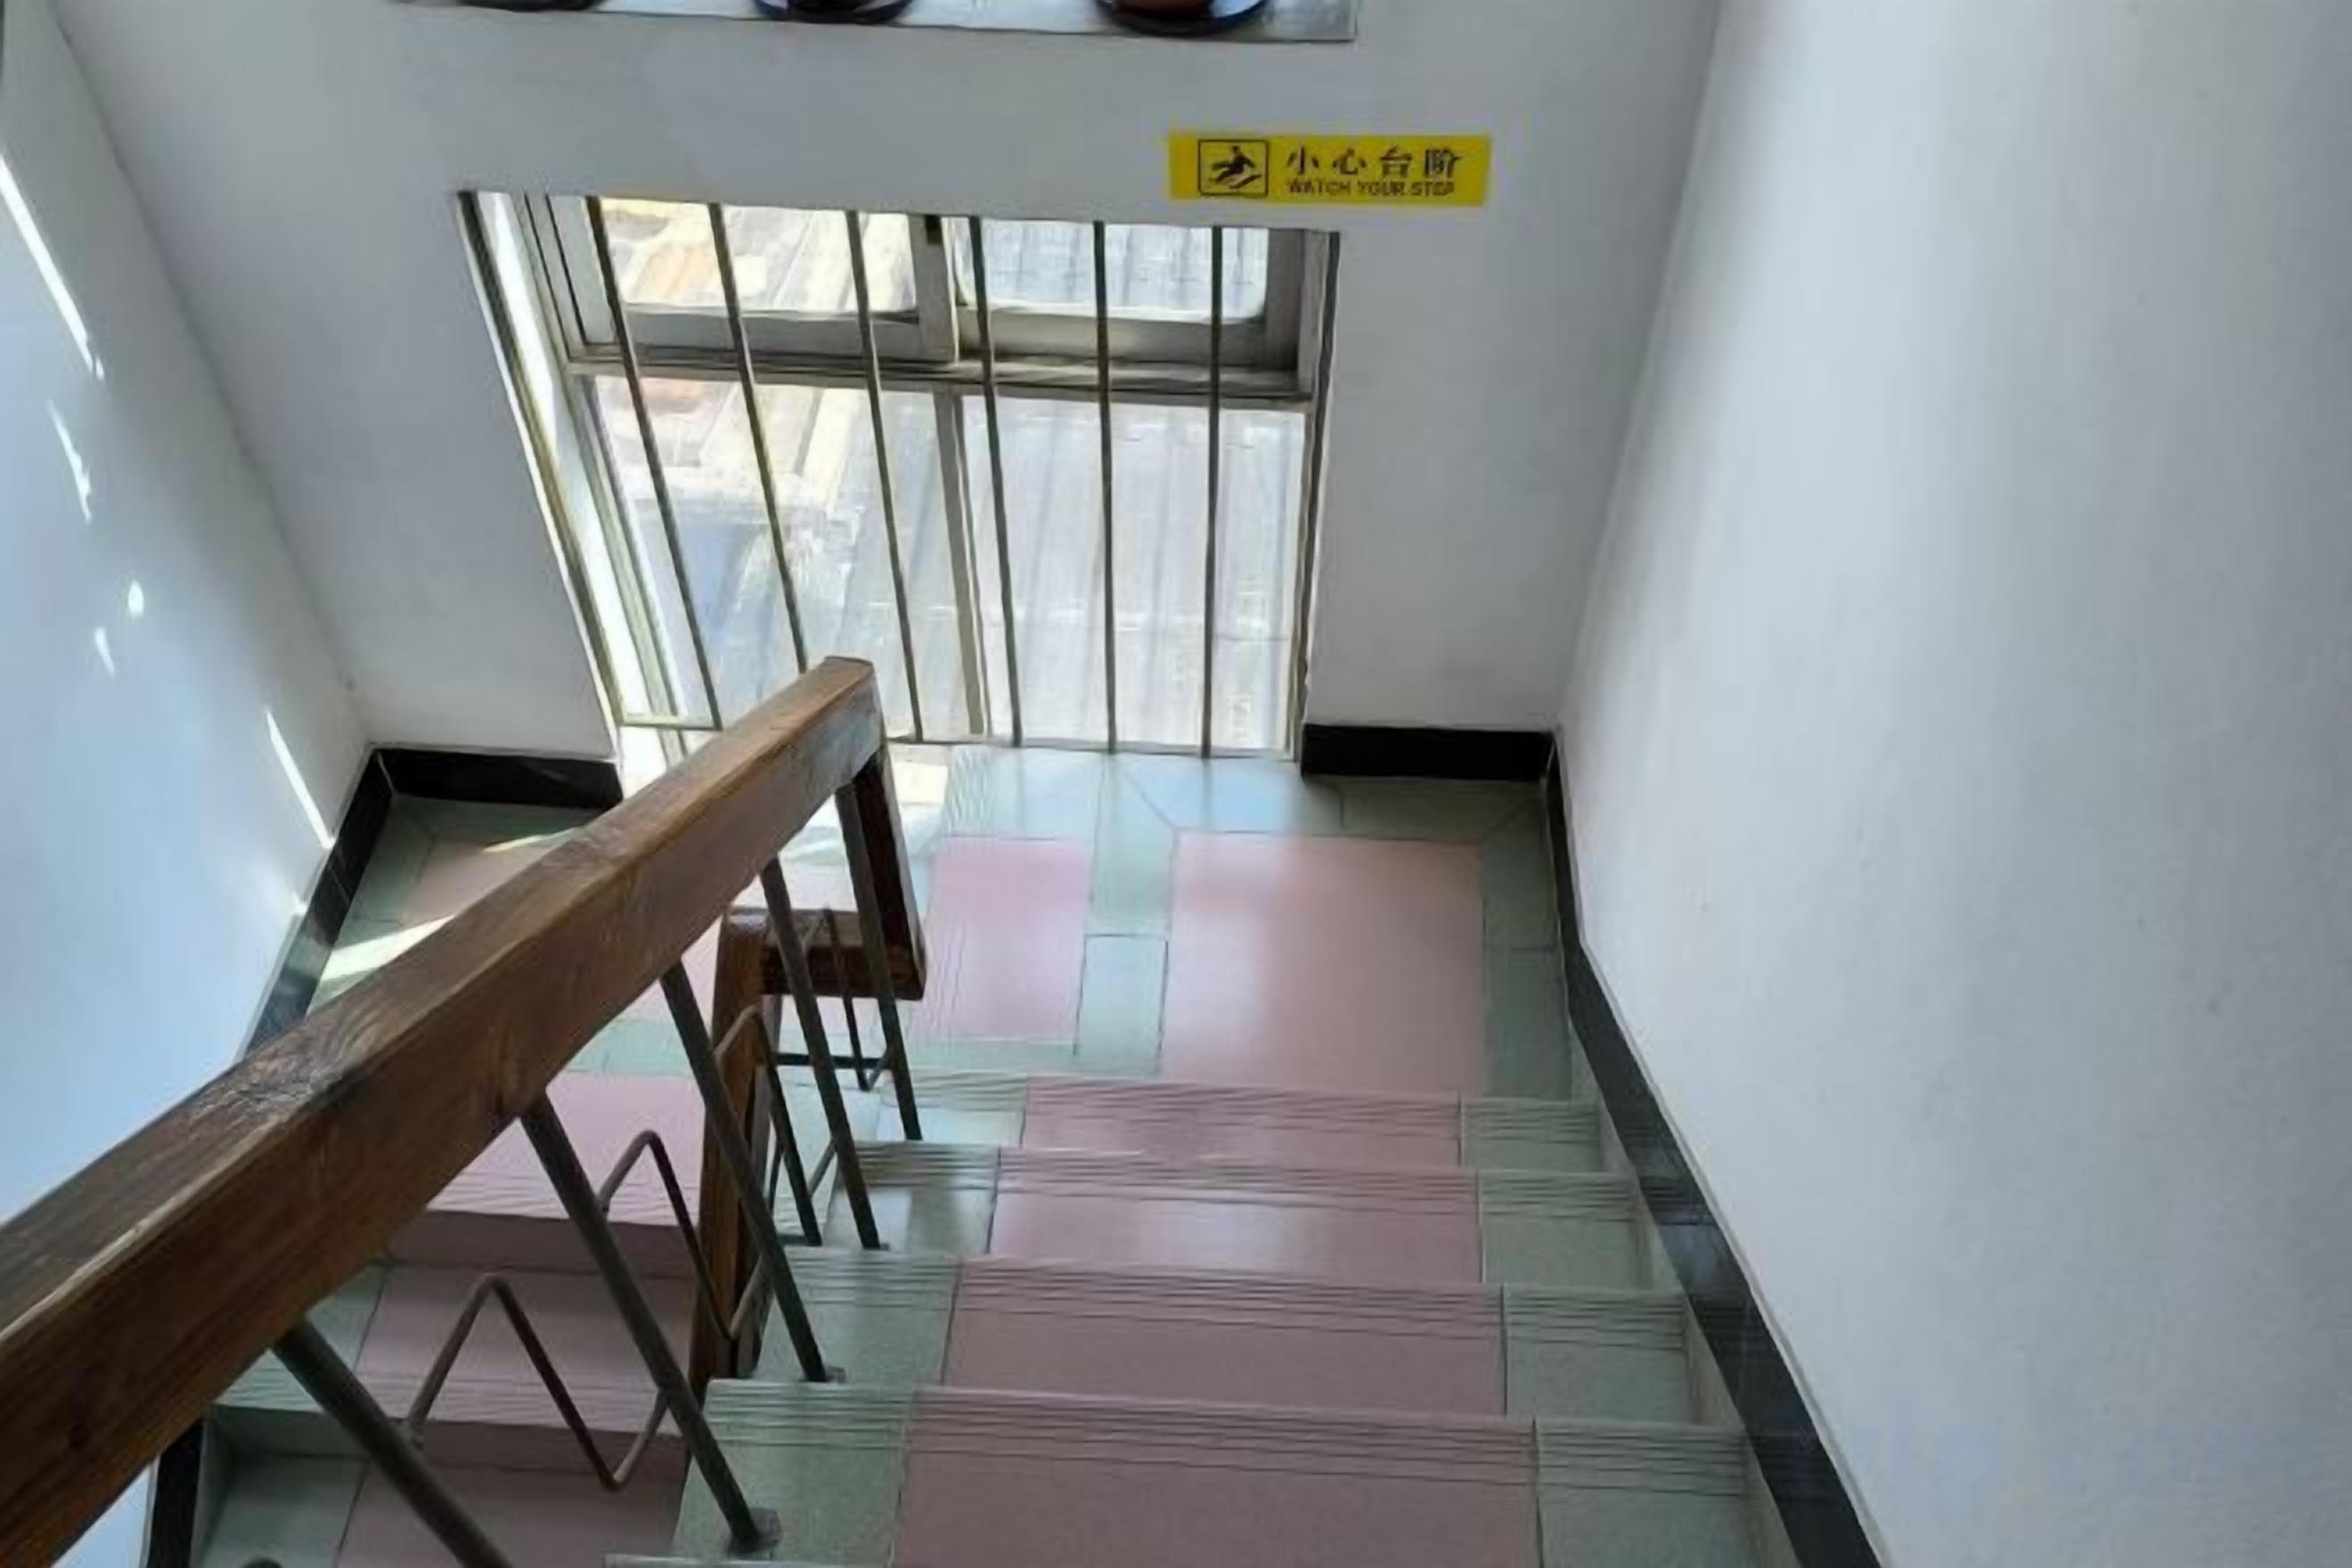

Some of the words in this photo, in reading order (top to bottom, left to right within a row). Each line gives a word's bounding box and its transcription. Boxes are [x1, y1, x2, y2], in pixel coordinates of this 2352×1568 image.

[1287, 143, 1460, 178] 小心台阶
[1287, 180, 1351, 195] WATCH
[1358, 181, 1405, 196] YOUR
[1411, 181, 1455, 197] STEP
